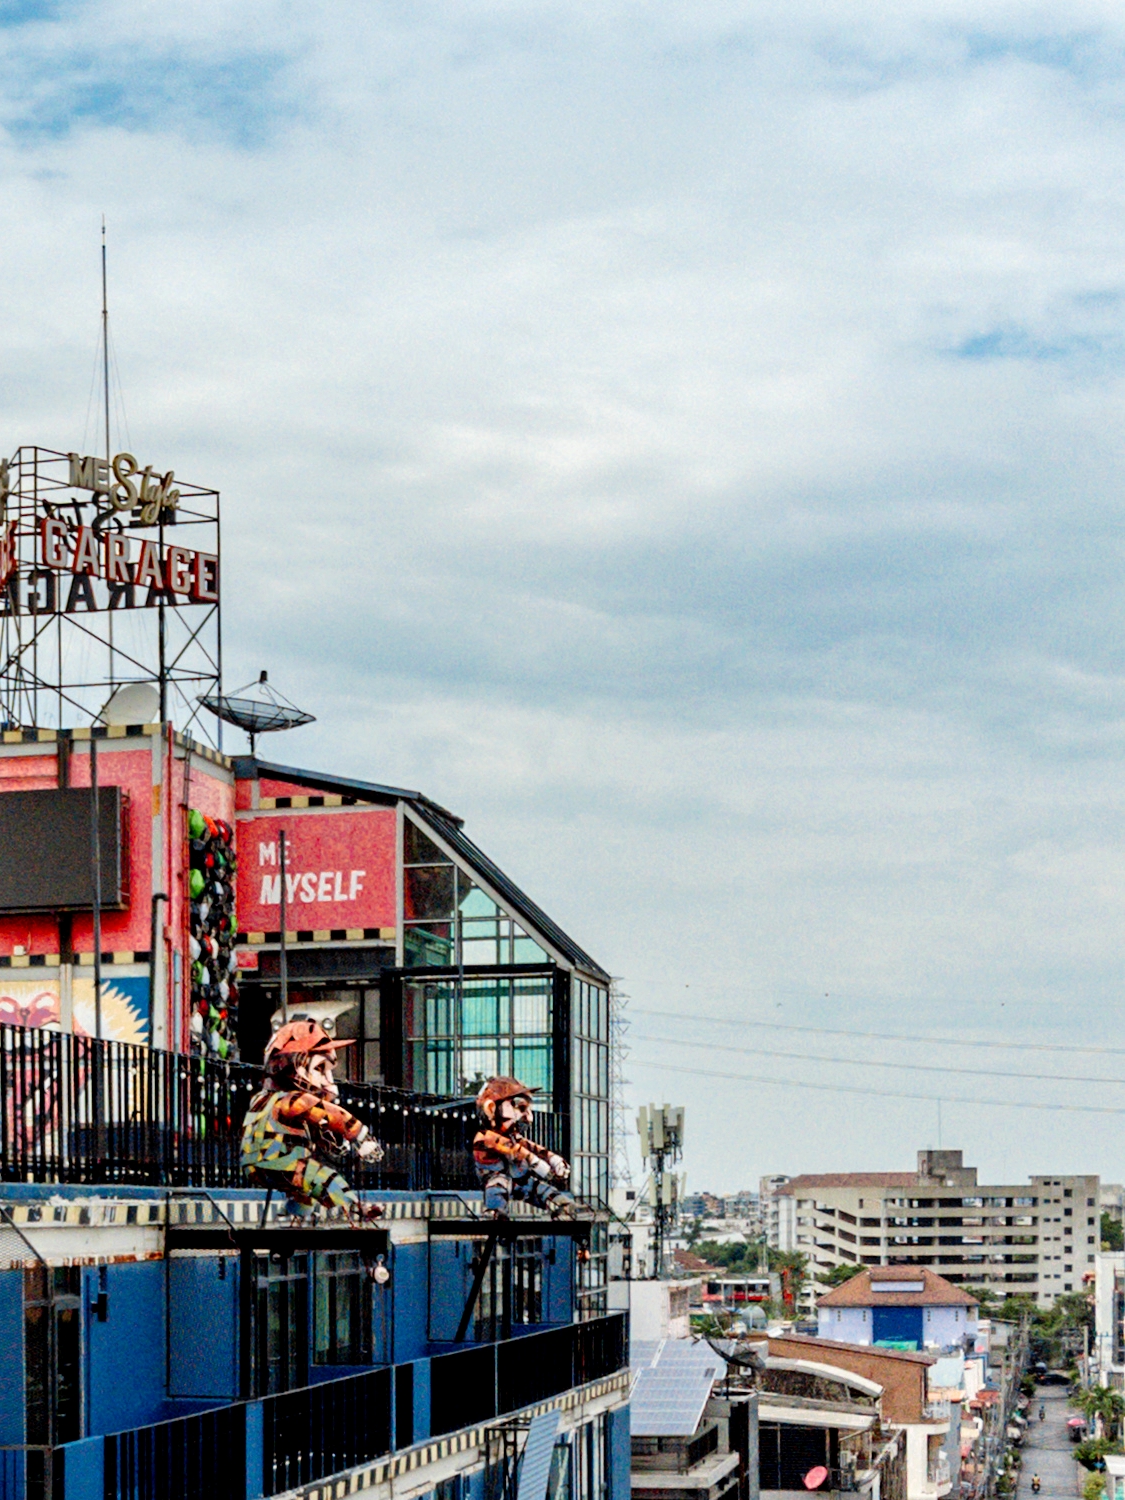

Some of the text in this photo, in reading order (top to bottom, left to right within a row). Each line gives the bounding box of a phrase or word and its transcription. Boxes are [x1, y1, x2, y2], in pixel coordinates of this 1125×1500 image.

[68, 452, 180, 525] ME Style
[41, 518, 219, 602] GARAGE
[259, 841, 291, 866] ME
[259, 870, 366, 905] MYSELF
